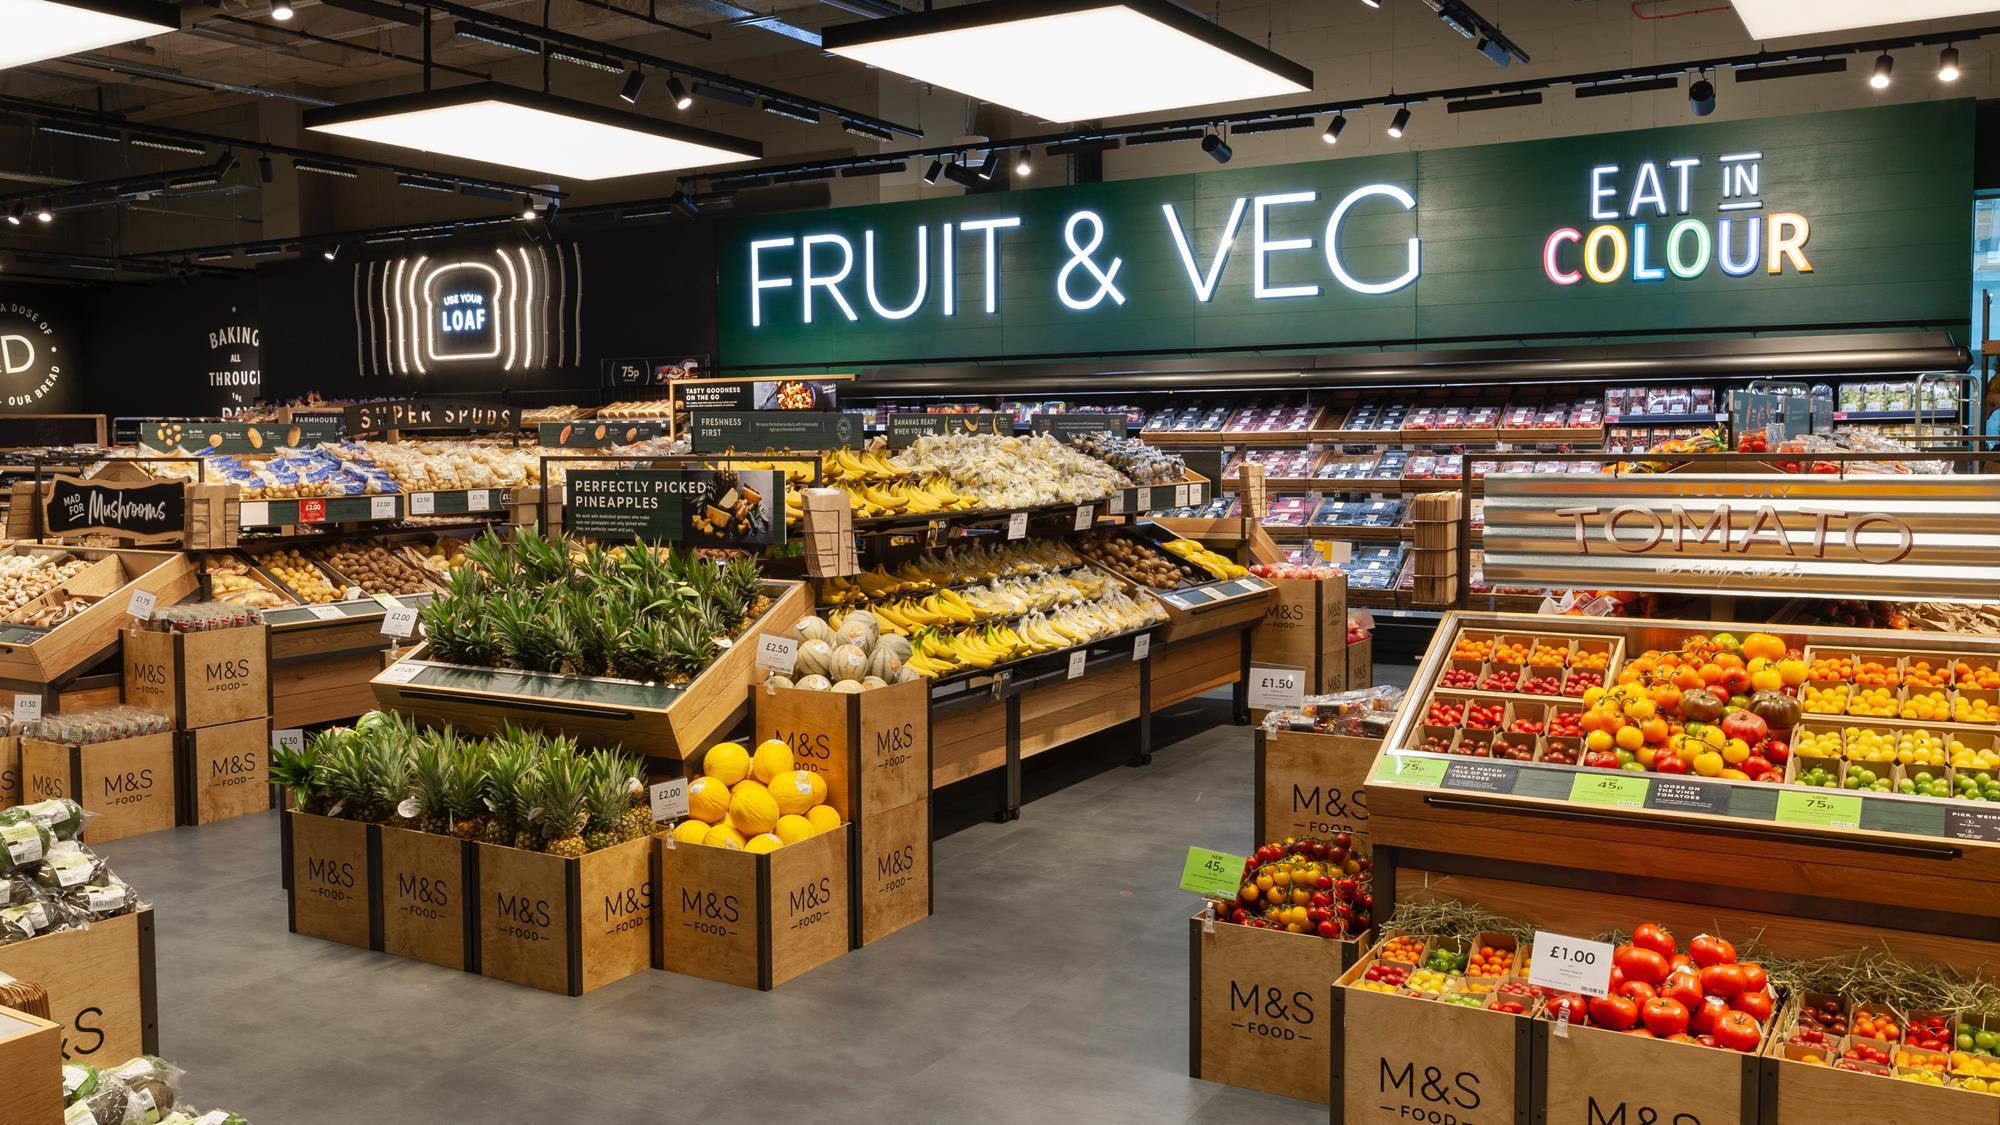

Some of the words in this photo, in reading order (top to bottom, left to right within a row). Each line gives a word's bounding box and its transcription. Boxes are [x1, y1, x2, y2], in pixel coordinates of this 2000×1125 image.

[1591, 158, 1701, 220] EAT
[1723, 162, 1759, 198] IN
[750, 217, 1021, 327] FRUIT
[1057, 210, 1126, 310] &
[1162, 183, 1420, 303] VEG
[1543, 212, 1814, 286] COLOUR
[443, 294, 459, 306] USE
[460, 293, 483, 305] YOUR
[11, 303, 39, 322] DOSE
[40, 321, 52, 335] OF
[442, 308, 486, 332] LOAF
[209, 326, 259, 349] BAKING
[230, 353, 241, 363] ALL
[621, 365, 640, 379] 75p
[8, 394, 32, 406] OUR
[34, 365, 60, 399] BREAD
[706, 386, 741, 394] GOODNESS
[295, 416, 338, 424] FARMHOUSE
[701, 417, 742, 426] FRESHNESS
[701, 428, 722, 437] FIRST
[575, 480, 649, 493] PERFECTLY
[655, 481, 708, 494] PICKED
[1679, 483, 1726, 497] YOU
[1743, 484, 1791, 498] SAY
[64, 493, 81, 507] MAD
[88, 490, 166, 525] Mushrooms
[575, 496, 659, 509] PINEAPPLES
[69, 503, 85, 516] FOR
[1555, 503, 1914, 565] TOMATO
[1655, 564, 1681, 577] we
[1690, 564, 1731, 588] say
[1741, 564, 1803, 583] sweet
[391, 612, 411, 622] £2.00
[1264, 604, 1304, 621] M&S
[1328, 601, 1341, 618] M&S
[766, 642, 789, 655] £2.50
[134, 662, 166, 685] M&S
[206, 658, 250, 683] M&S
[1353, 664, 1367, 680] M&S
[141, 686, 159, 695] FOOD
[216, 682, 241, 692] FOOD
[1261, 677, 1294, 689] £1.50
[20, 700, 36, 708] £1.50
[876, 723, 913, 756] M&S
[212, 752, 256, 777] M&S
[793, 762, 818, 773] OOD
[884, 754, 906, 769] FOOD
[1402, 763, 1425, 772] 75p
[104, 769, 153, 796] M&S
[222, 776, 247, 788] FOOD
[1451, 773, 1490, 781] TOMATOES
[1483, 771, 1507, 779] WIGHT
[32, 773, 63, 798] M&S
[658, 787, 681, 800] £2.00
[1597, 781, 1624, 791] 45p
[1658, 783, 1686, 791] LOOSE
[115, 794, 143, 806] FOOD
[1293, 783, 1369, 821] M&S
[1656, 792, 1701, 800] TOMATOES
[1806, 800, 1834, 810] 75p
[1309, 821, 1353, 834] FOOD
[877, 845, 913, 882] M&S
[1204, 860, 1225, 874] 45p
[308, 856, 355, 888] M&S
[399, 872, 448, 906] M&S
[885, 877, 906, 892] FOOD
[318, 886, 345, 901] FOOD
[789, 877, 831, 918] M&S
[497, 892, 551, 928] M&S
[605, 882, 652, 922] M&S
[681, 887, 740, 923] M&S
[409, 905, 438, 920] FOOD
[799, 911, 823, 929] FOOD
[616, 917, 643, 934] FOOD
[694, 921, 727, 937] FOOD
[508, 926, 540, 942] FOOD
[1550, 945, 1596, 965] £1.00
[1230, 979, 1315, 1025] M&S
[1248, 1021, 1295, 1041] FOOD
[1380, 1056, 1481, 1110] M&S
[1401, 1104, 1456, 1125] FOOD
